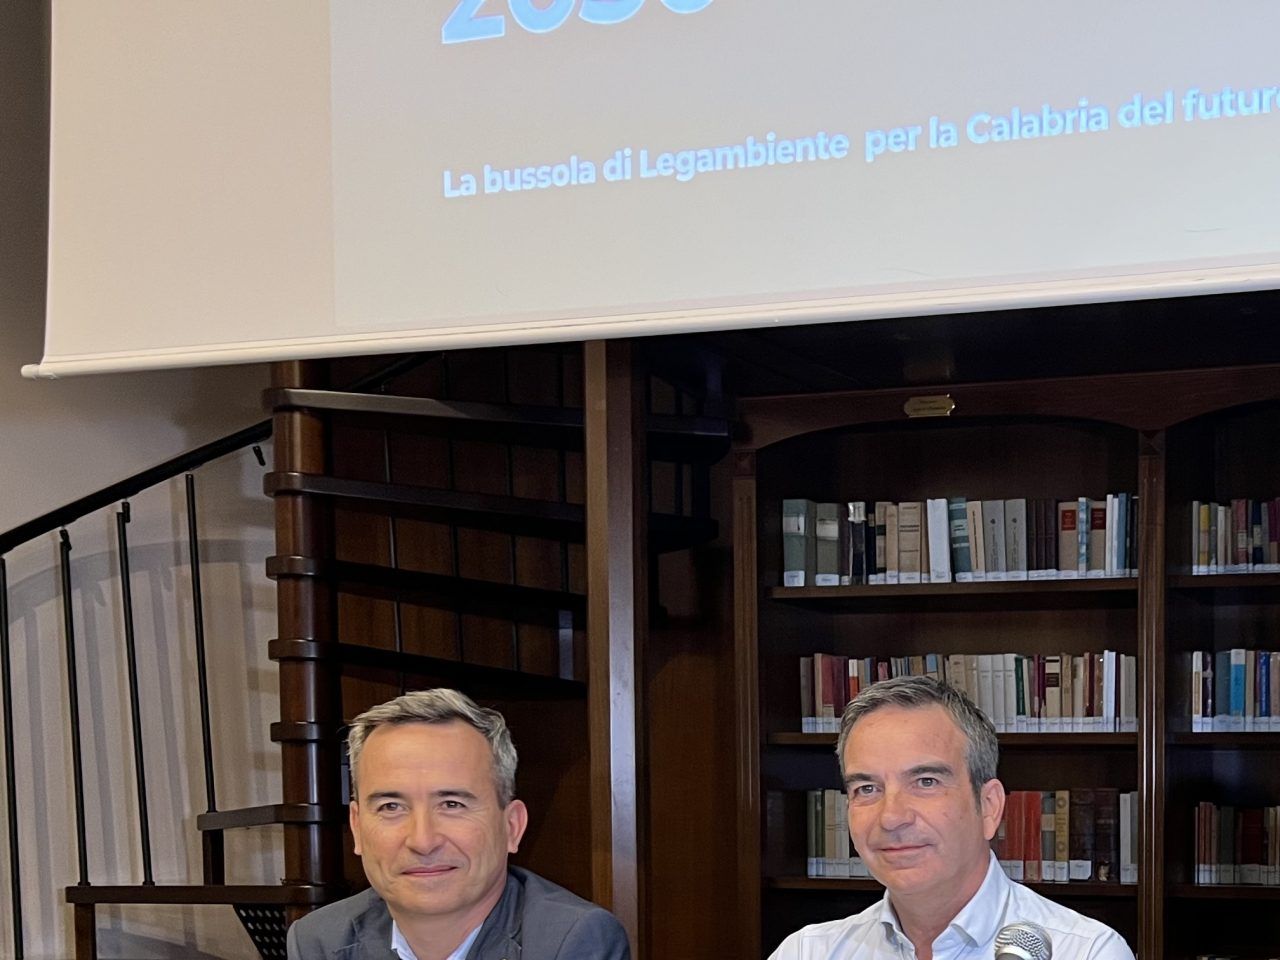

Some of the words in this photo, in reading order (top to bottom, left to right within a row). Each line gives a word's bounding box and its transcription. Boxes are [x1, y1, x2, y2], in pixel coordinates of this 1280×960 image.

[443, 170, 477, 198] La
[484, 155, 596, 194] bussola
[603, 147, 632, 181] di
[640, 131, 850, 182] Legambiente
[864, 124, 922, 162] per
[930, 116, 959, 149] la
[966, 97, 1109, 144] Calabria
[1117, 90, 1174, 128] del
